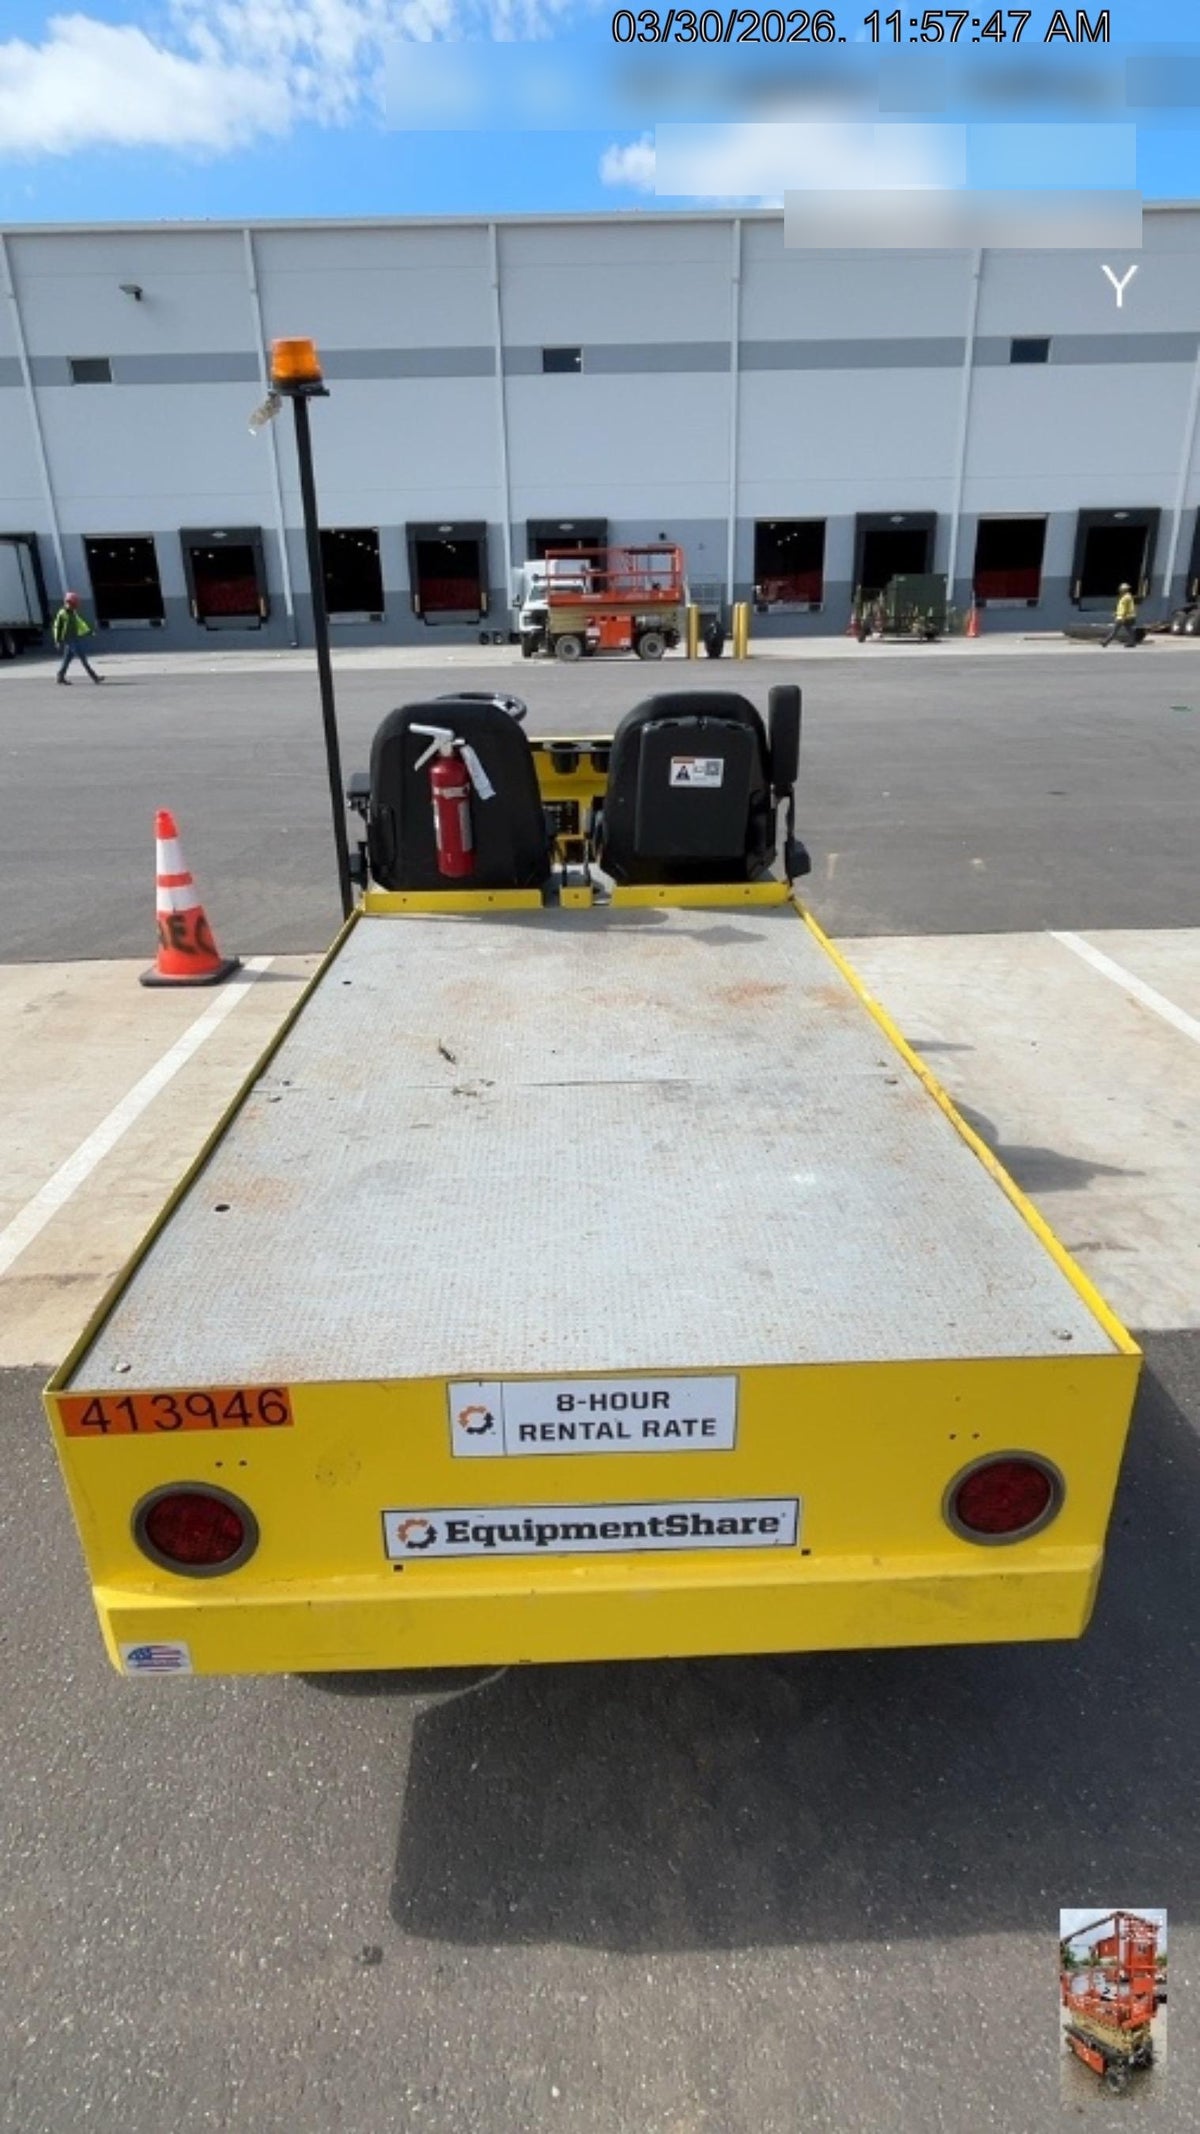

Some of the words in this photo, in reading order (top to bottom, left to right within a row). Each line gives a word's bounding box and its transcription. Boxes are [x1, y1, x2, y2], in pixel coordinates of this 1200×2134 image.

[80, 1388, 289, 1434] 413946
[556, 1391, 671, 1412] 8-HOUR
[519, 1420, 632, 1442] RENTAL
[641, 1418, 718, 1438] RATE
[444, 1513, 780, 1548] EquipmentShare
